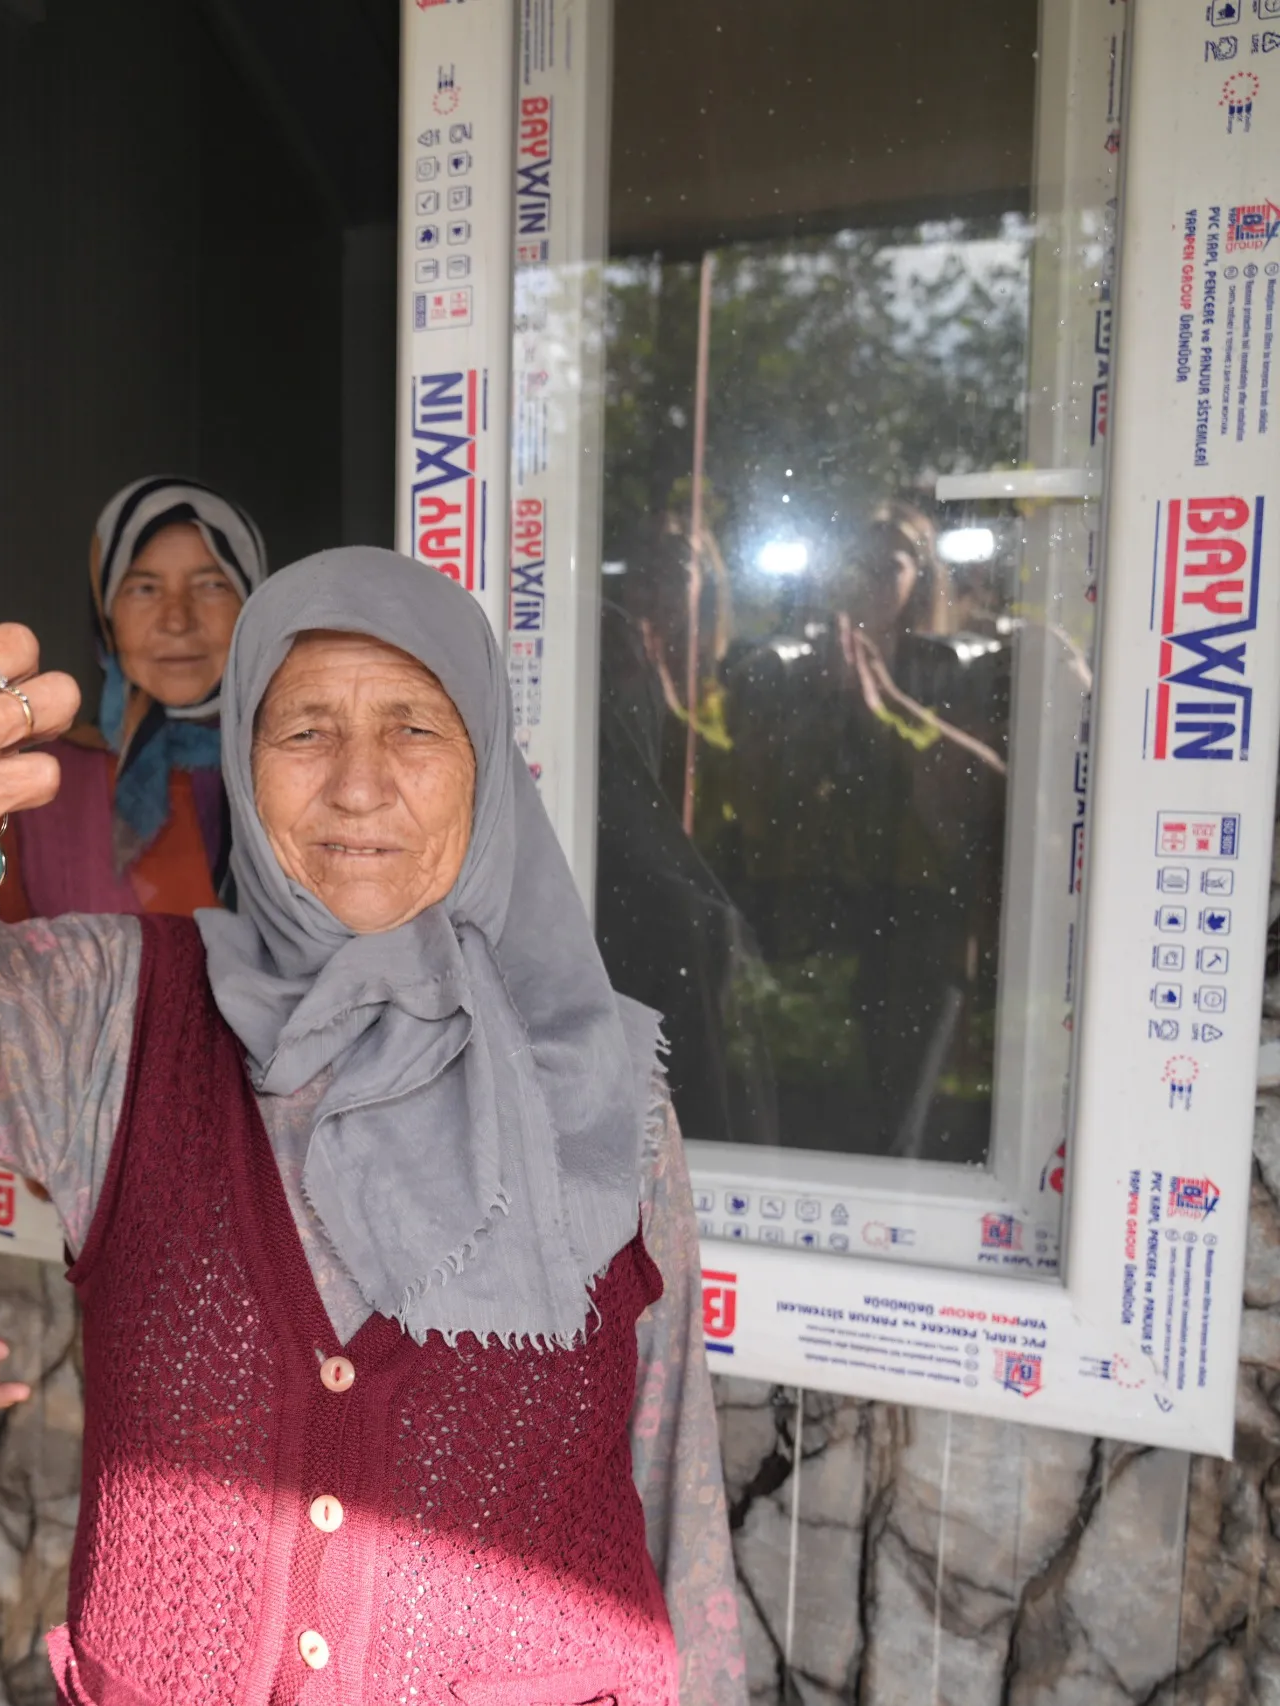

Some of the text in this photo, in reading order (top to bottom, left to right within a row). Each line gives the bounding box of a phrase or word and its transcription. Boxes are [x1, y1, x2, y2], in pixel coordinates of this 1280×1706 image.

[517, 95, 552, 235] BAYWIN
[1209, 207, 1220, 229] PVC
[1176, 209, 1197, 383] YAPIPEN GROUP ÜRÜNÜDÜR
[1202, 271, 1217, 325] PENCERE
[1201, 328, 1210, 342] ve
[1198, 347, 1212, 395] PANJUR
[1194, 399, 1211, 467] SİSTEMLERİ
[509, 497, 544, 631] BAYWIN
[1159, 495, 1265, 761] BAYWIN
[1151, 1172, 1162, 1191] PVC
[1125, 1219, 1137, 1261] GROUP
[1145, 1229, 1159, 1278] PENCERE
[938, 1306, 986, 1323] GROUP
[1121, 1264, 1137, 1325] ÜRÜNÜDÜR
[848, 1311, 897, 1328] PANJUR
[920, 1322, 977, 1339] PENCERE
[1142, 1297, 1154, 1340] PANJUR
[1021, 1336, 1046, 1349] PVC
